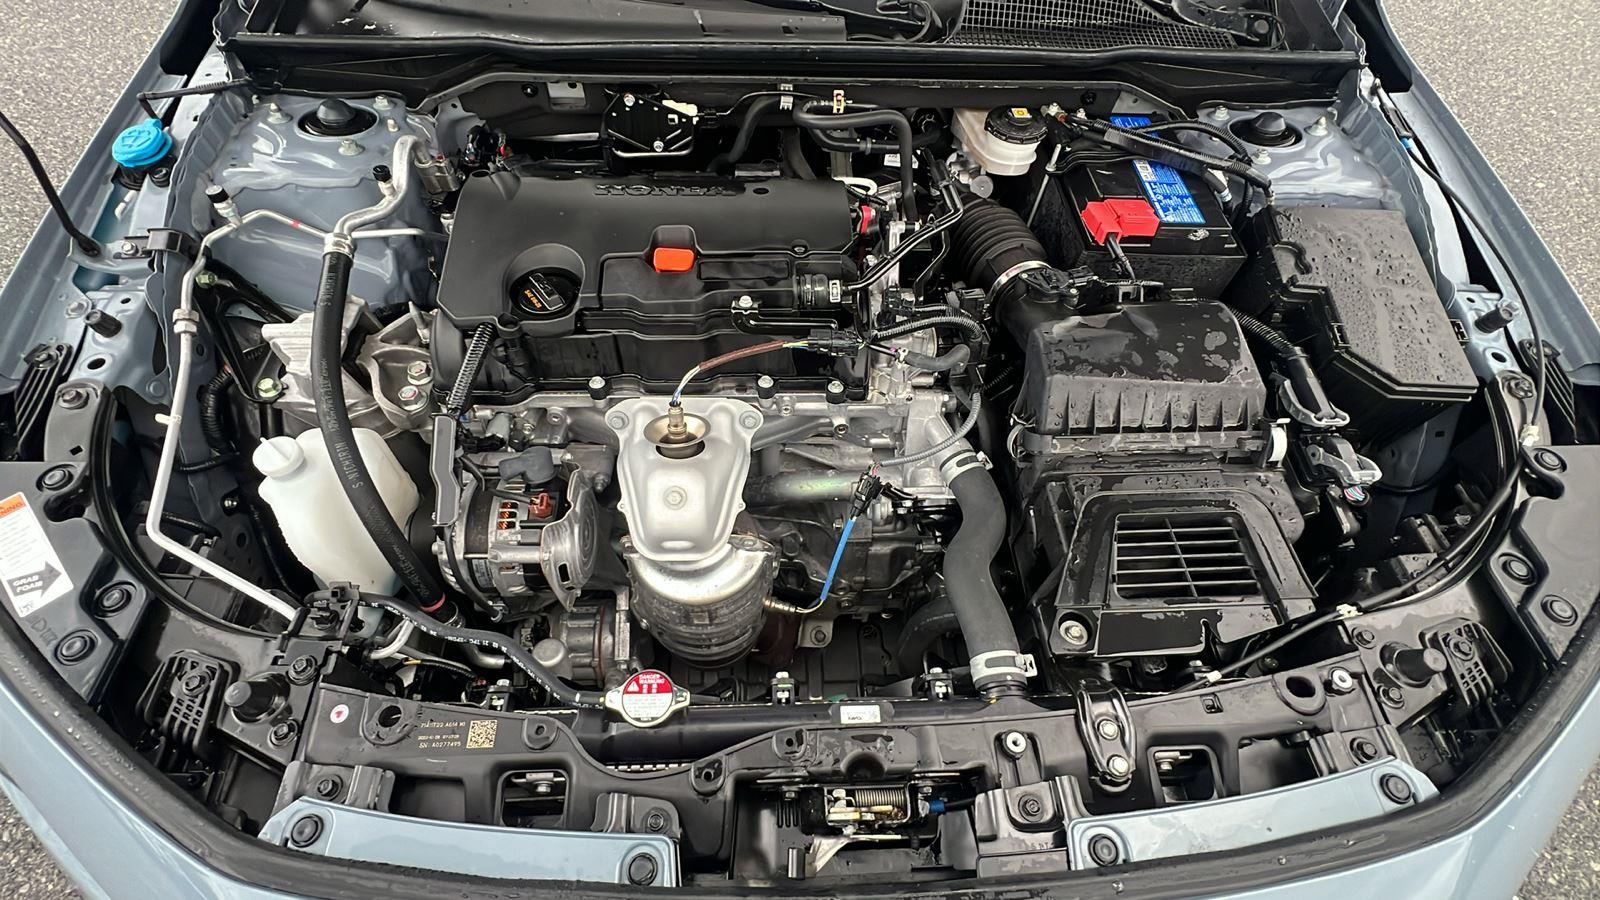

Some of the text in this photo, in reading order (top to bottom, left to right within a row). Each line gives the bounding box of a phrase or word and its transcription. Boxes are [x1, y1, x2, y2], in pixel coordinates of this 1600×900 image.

[594, 184, 737, 197] HONDA
[12, 574, 39, 587] GRAB
[16, 580, 44, 593] FOAM
